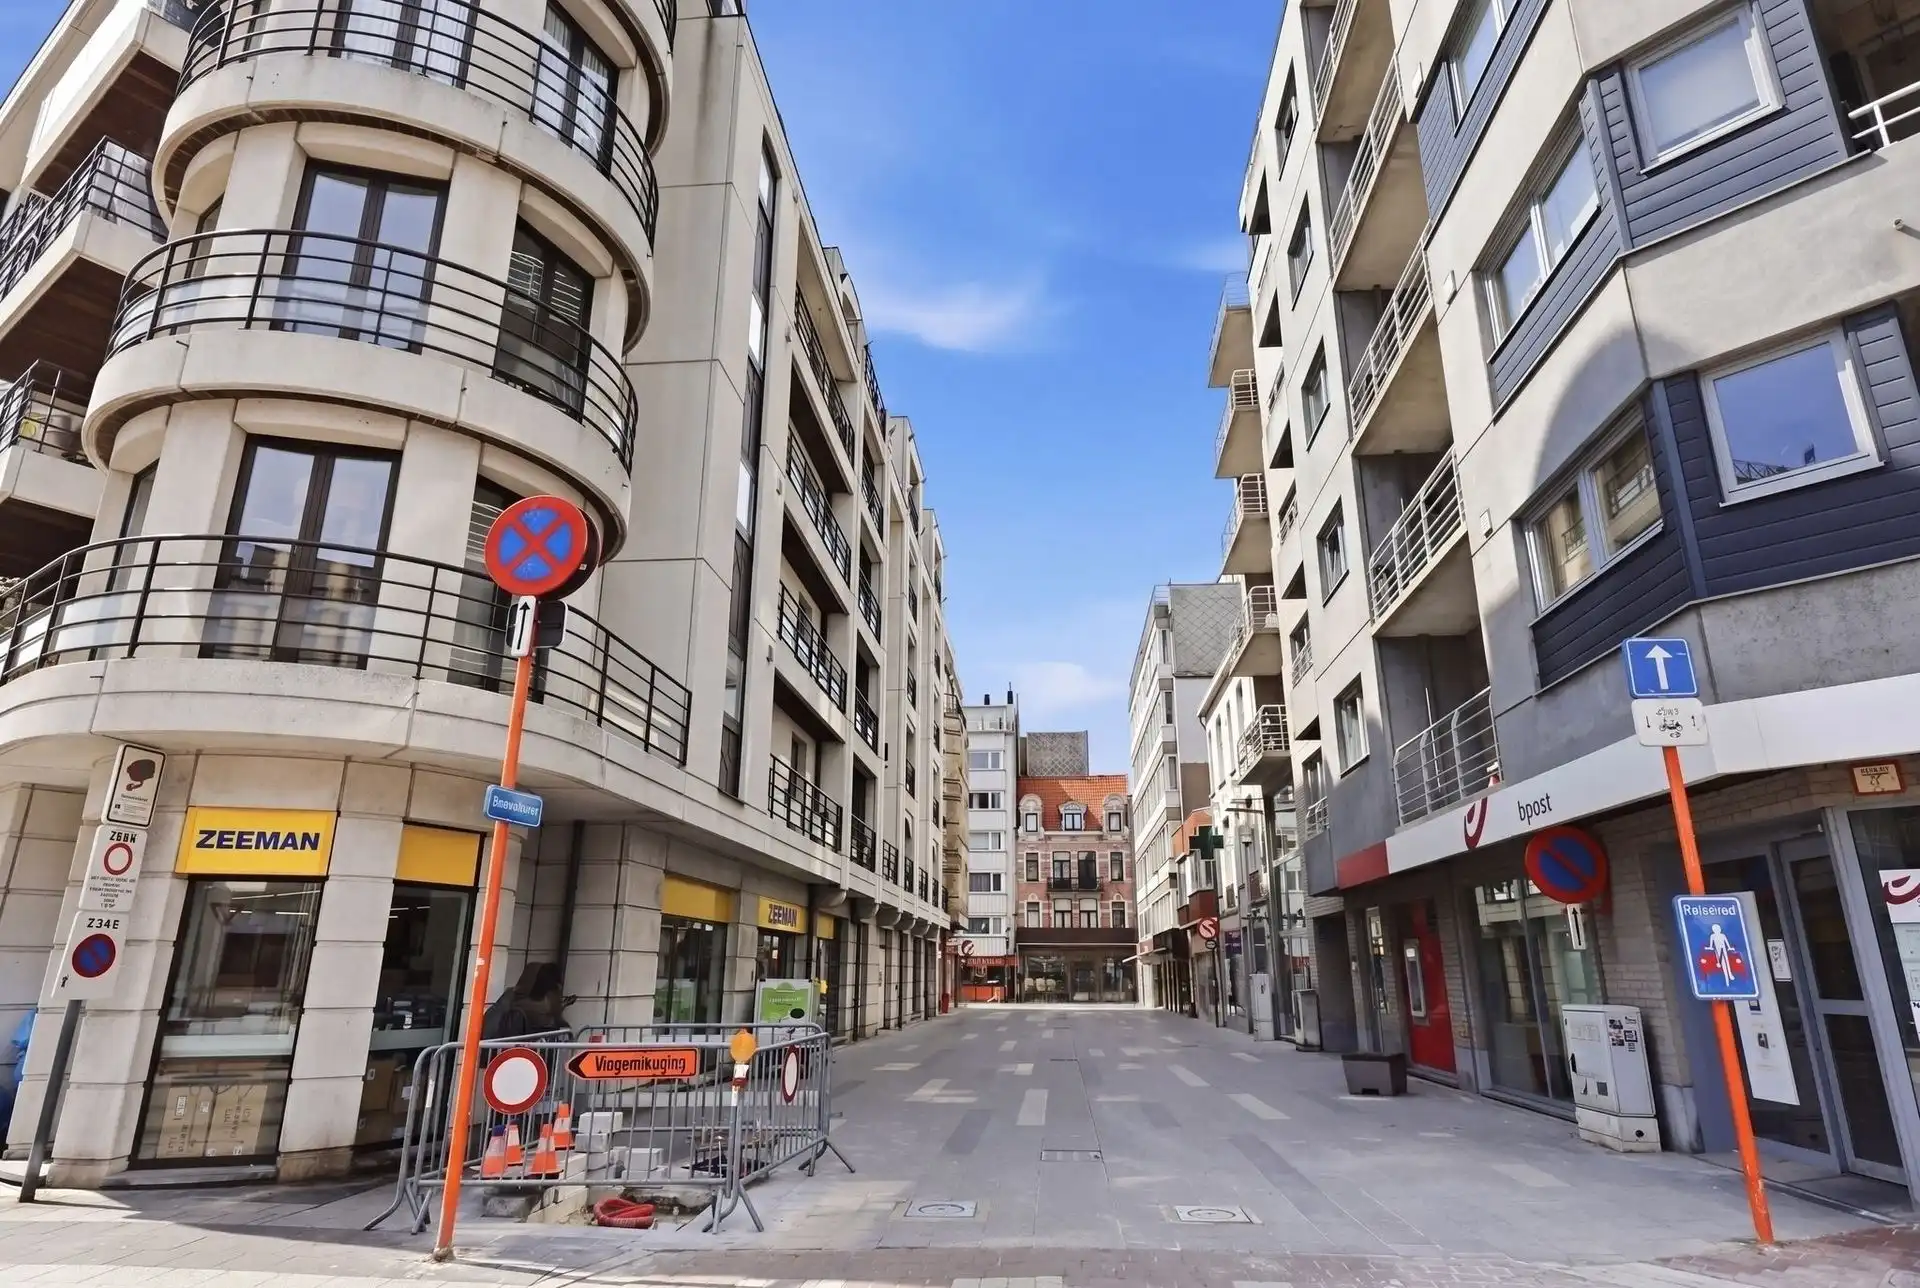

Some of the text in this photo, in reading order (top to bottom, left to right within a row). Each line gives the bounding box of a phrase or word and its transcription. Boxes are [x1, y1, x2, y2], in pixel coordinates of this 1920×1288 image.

[1517, 792, 1552, 825] bpost
[195, 829, 321, 851] ZEEMAN
[86, 917, 120, 930] Z34E
[768, 903, 798, 928] ZEEMAN
